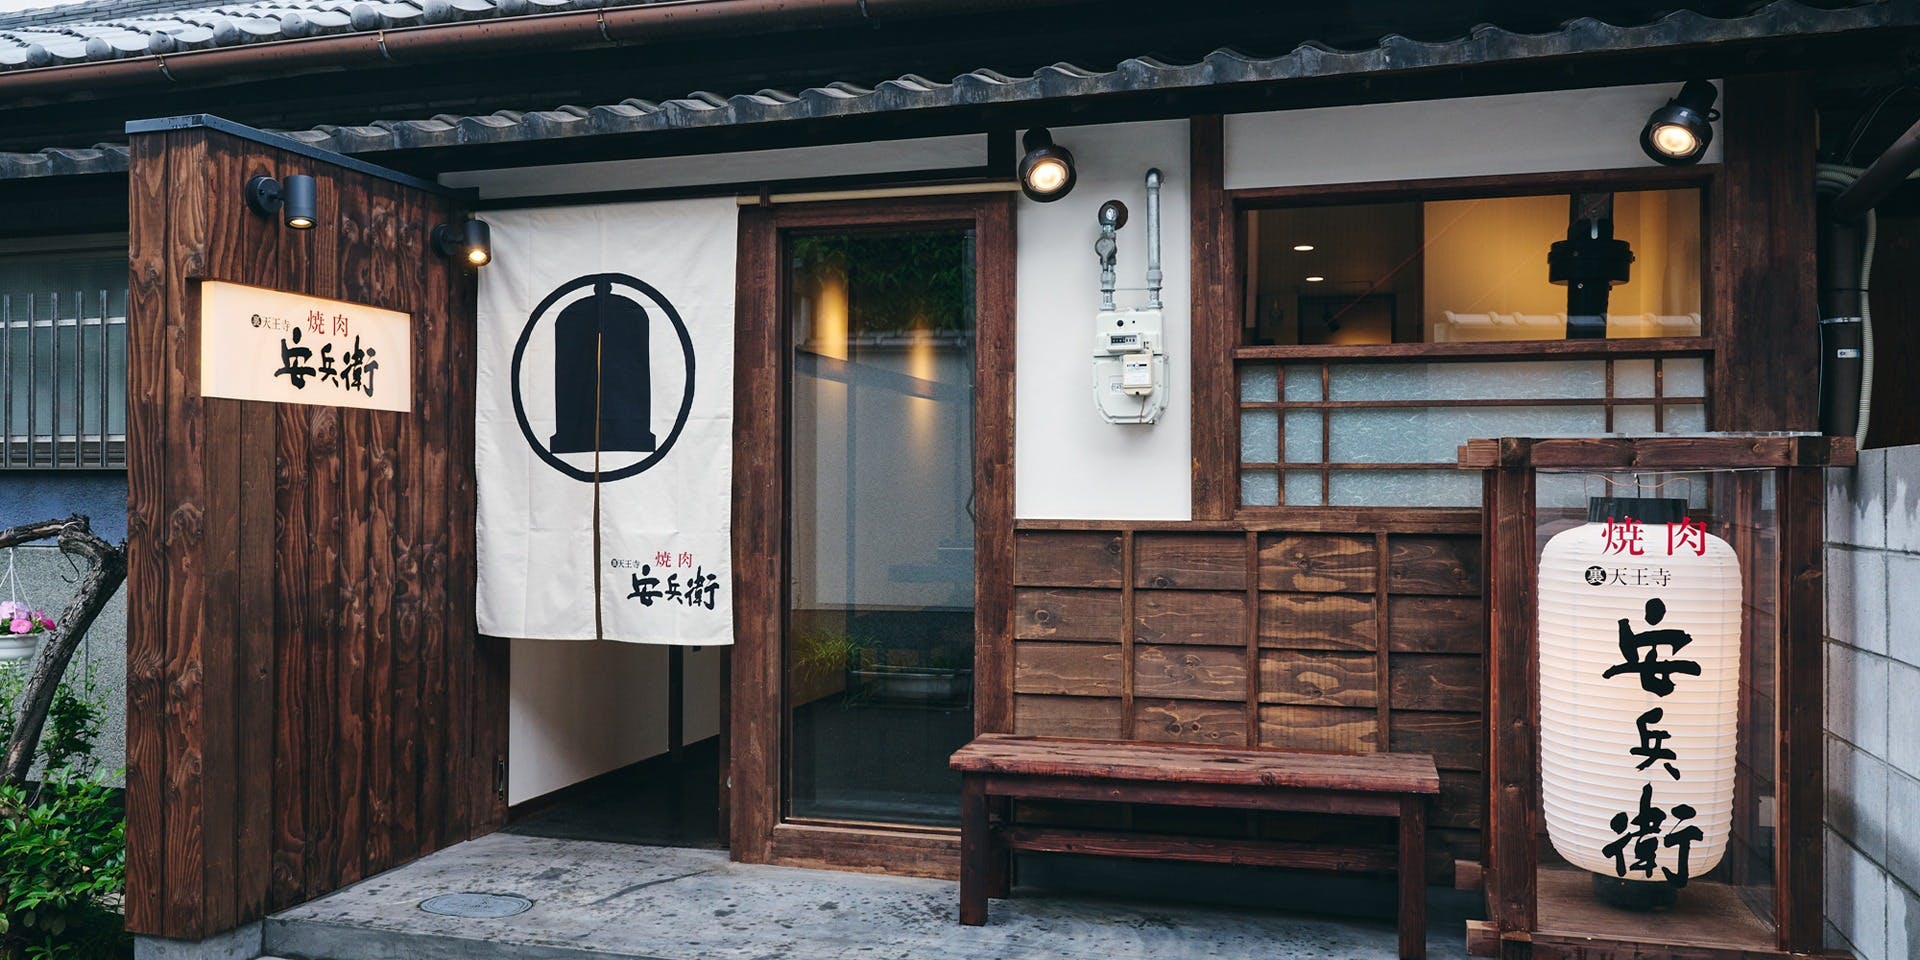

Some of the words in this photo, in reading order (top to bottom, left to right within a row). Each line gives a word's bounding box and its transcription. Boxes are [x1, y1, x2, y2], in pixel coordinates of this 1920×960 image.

[307, 309, 349, 337] 焼肉
[274, 326, 379, 398] 安兵衛
[1601, 516, 1707, 557] 焼肉
[655, 550, 694, 568] 焼肉
[626, 563, 720, 611] 安兵衛
